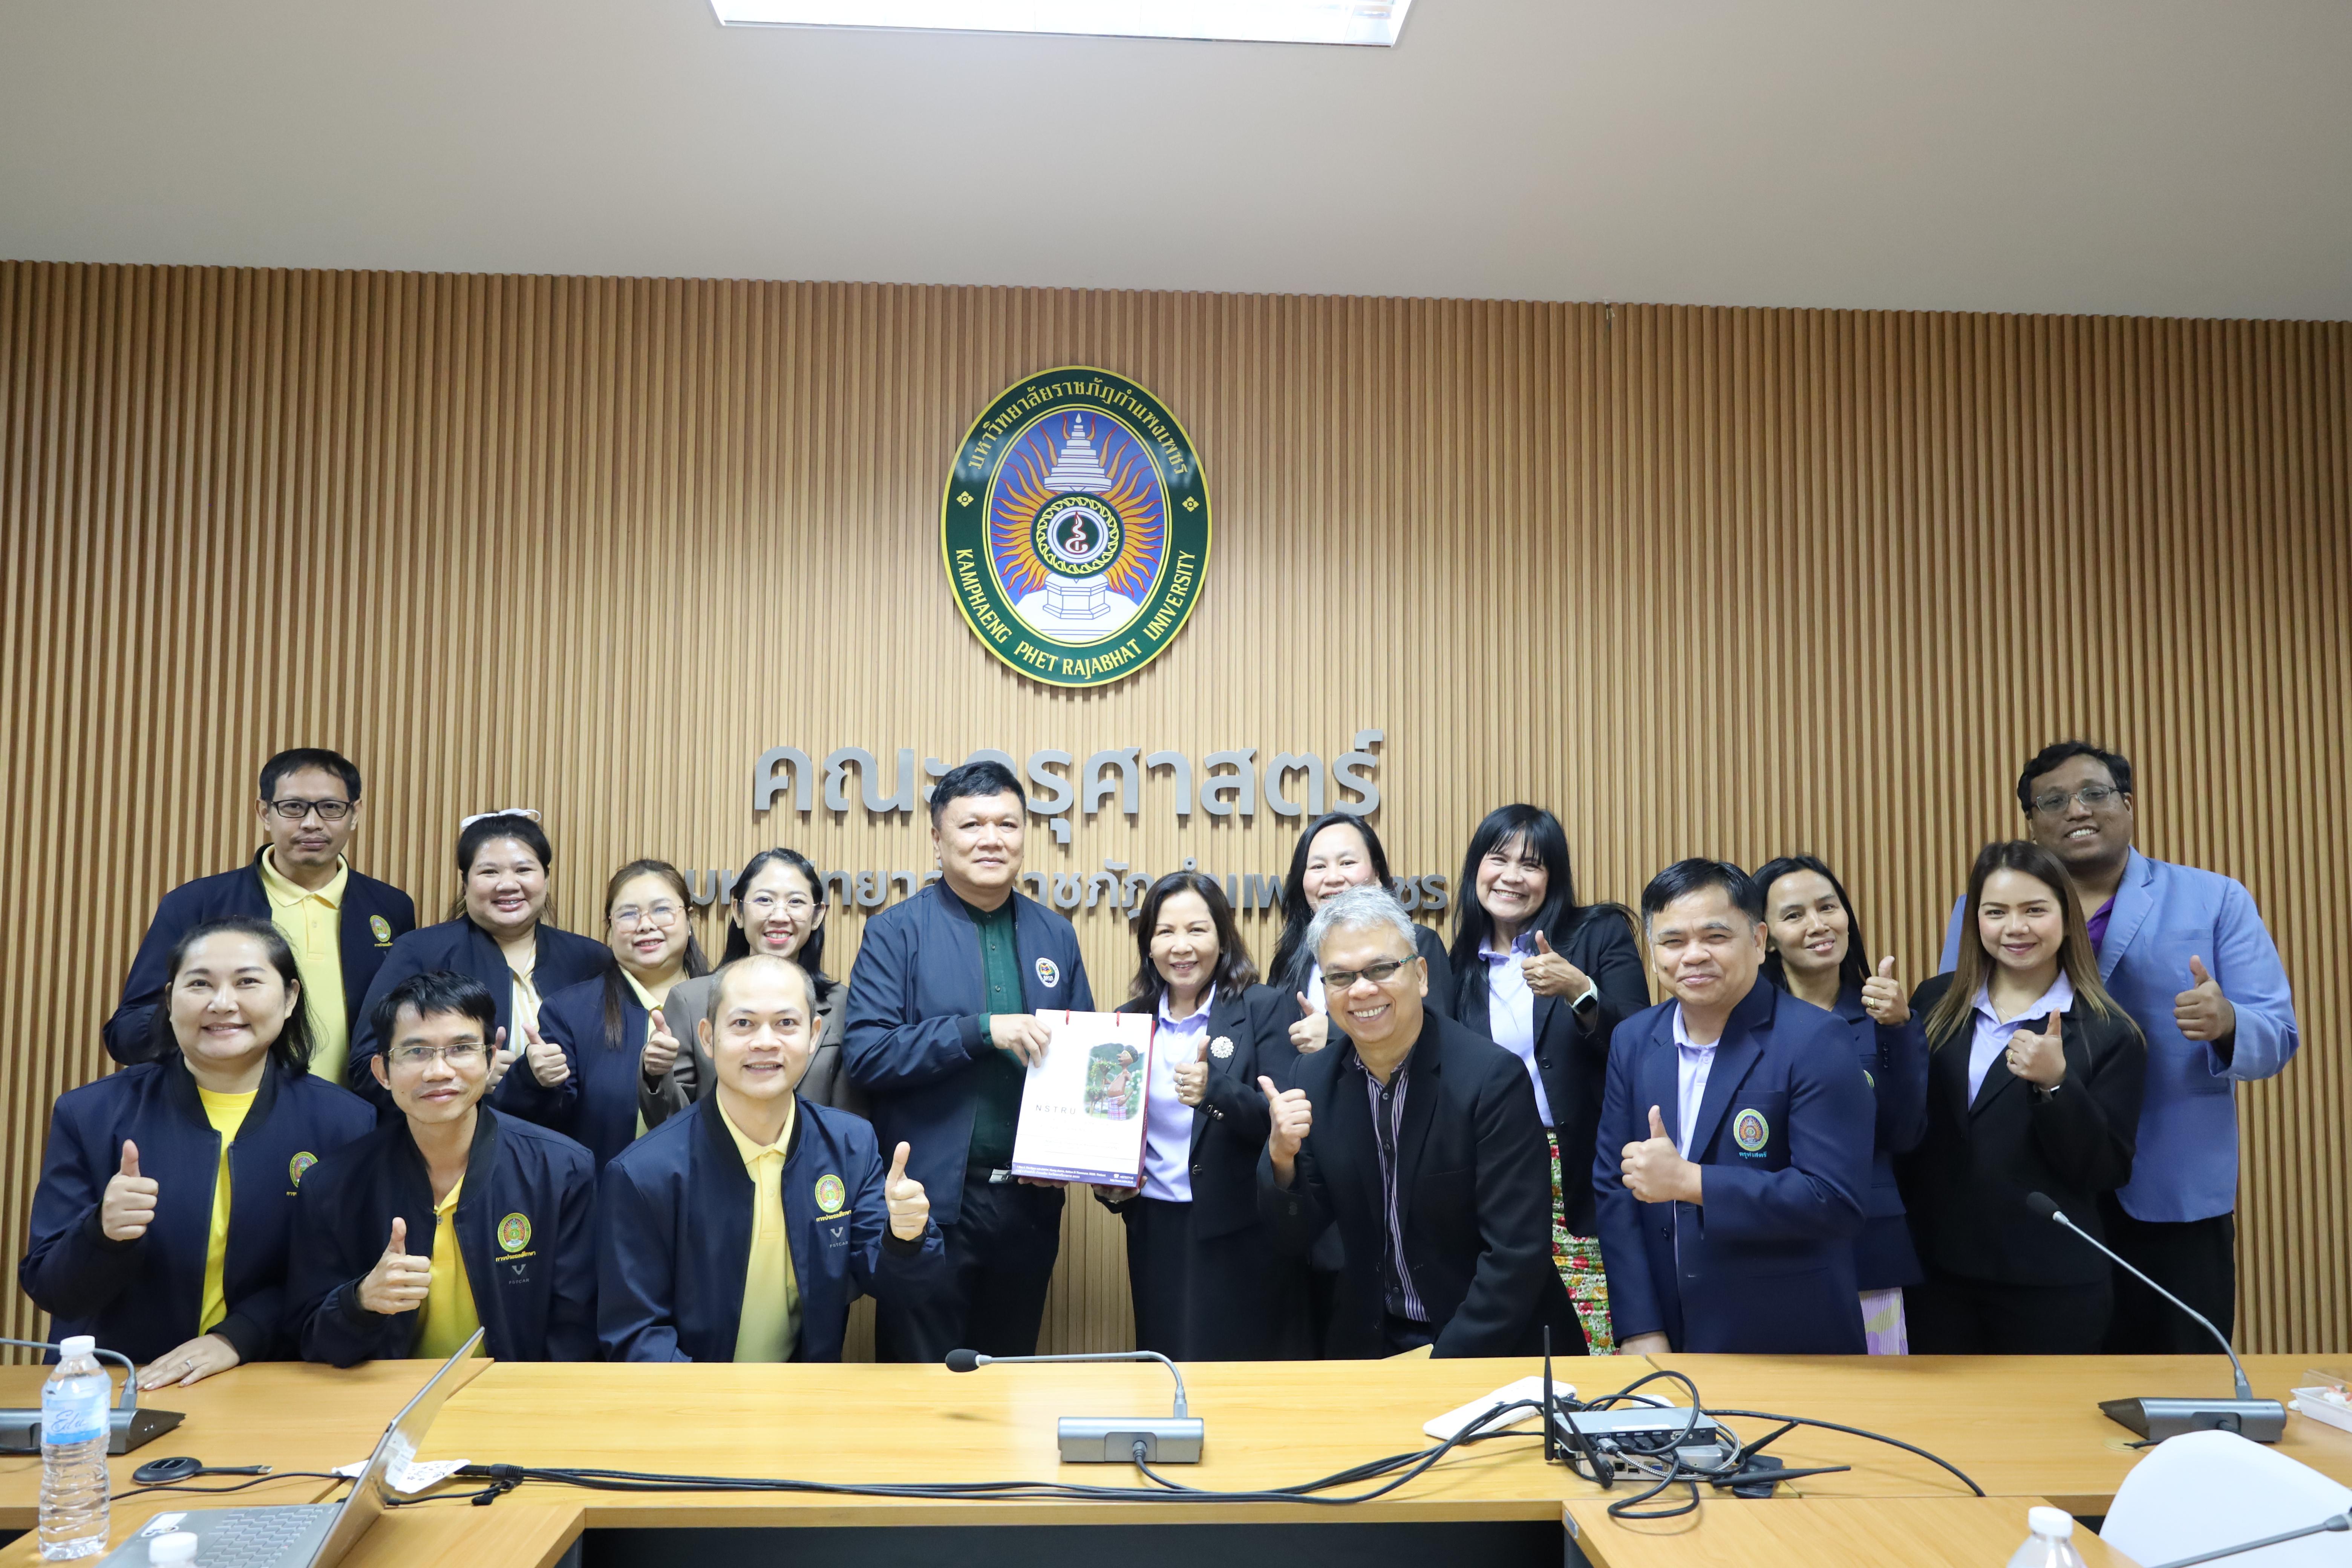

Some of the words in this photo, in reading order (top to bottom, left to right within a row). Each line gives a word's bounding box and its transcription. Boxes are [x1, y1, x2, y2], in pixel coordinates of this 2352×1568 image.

[968, 377, 1188, 475] มหาวิทยาลัยราชภัฏกำแพงเพชร
[956, 549, 1012, 643] KAMPHAENG
[1014, 641, 1059, 671] PHET
[1062, 638, 1142, 680] RAJABHAT
[1142, 550, 1196, 641] UNIVERSITY
[1035, 1104, 1076, 1115] NSTRU
